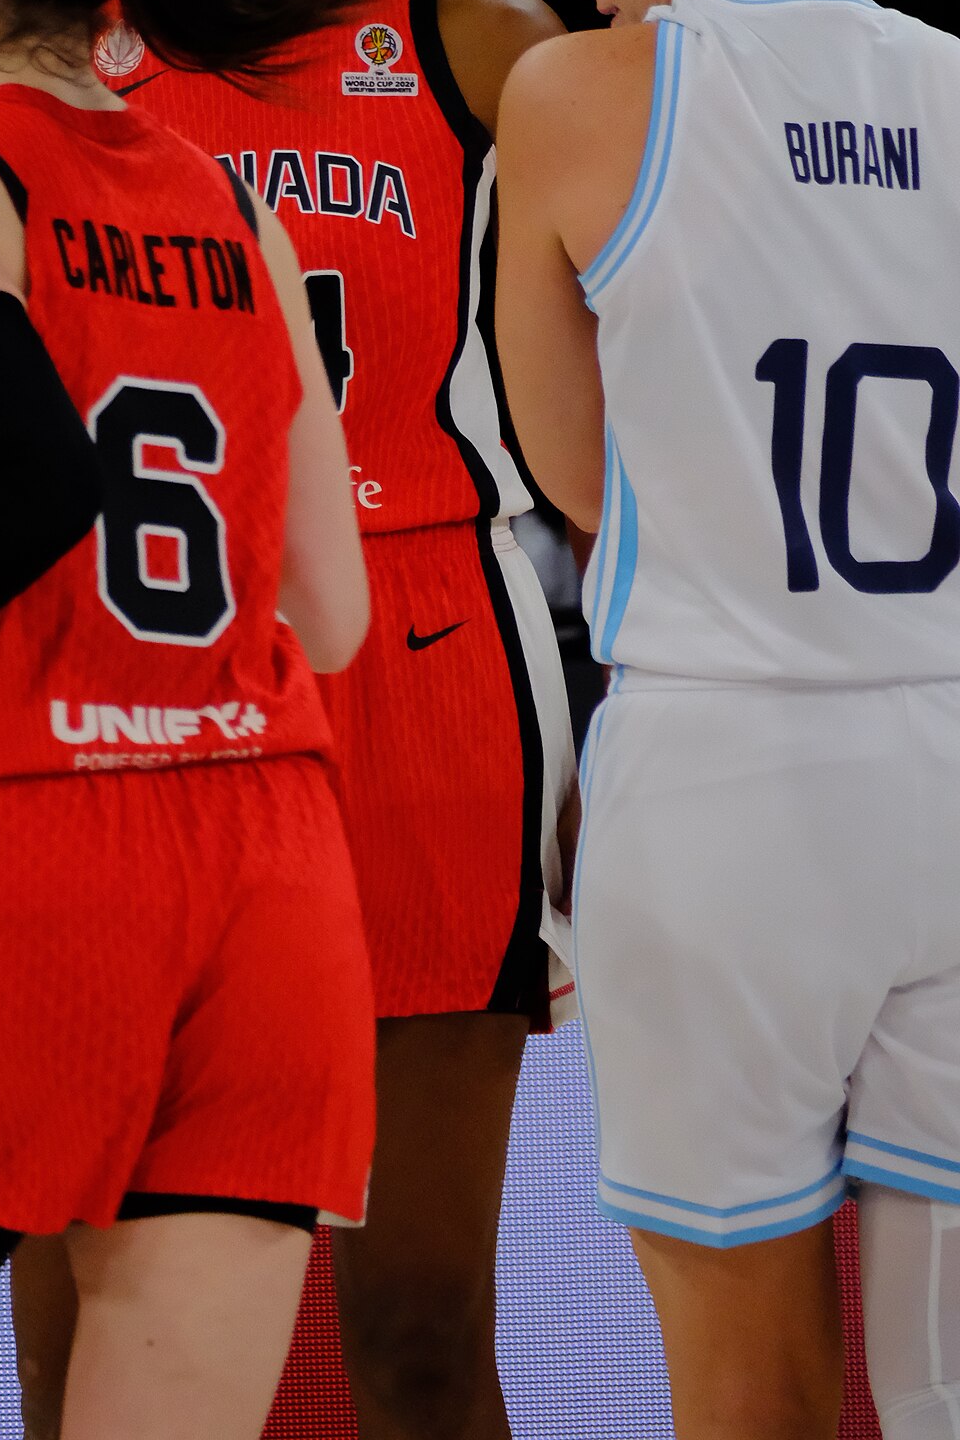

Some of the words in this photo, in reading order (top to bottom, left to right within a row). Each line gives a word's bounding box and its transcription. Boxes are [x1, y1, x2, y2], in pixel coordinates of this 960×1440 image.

[345, 80, 375, 88] WORLD
[784, 120, 921, 191] BURANI
[53, 218, 256, 315] CARLETON
[86, 374, 237, 648] 6
[755, 338, 960, 594] 10
